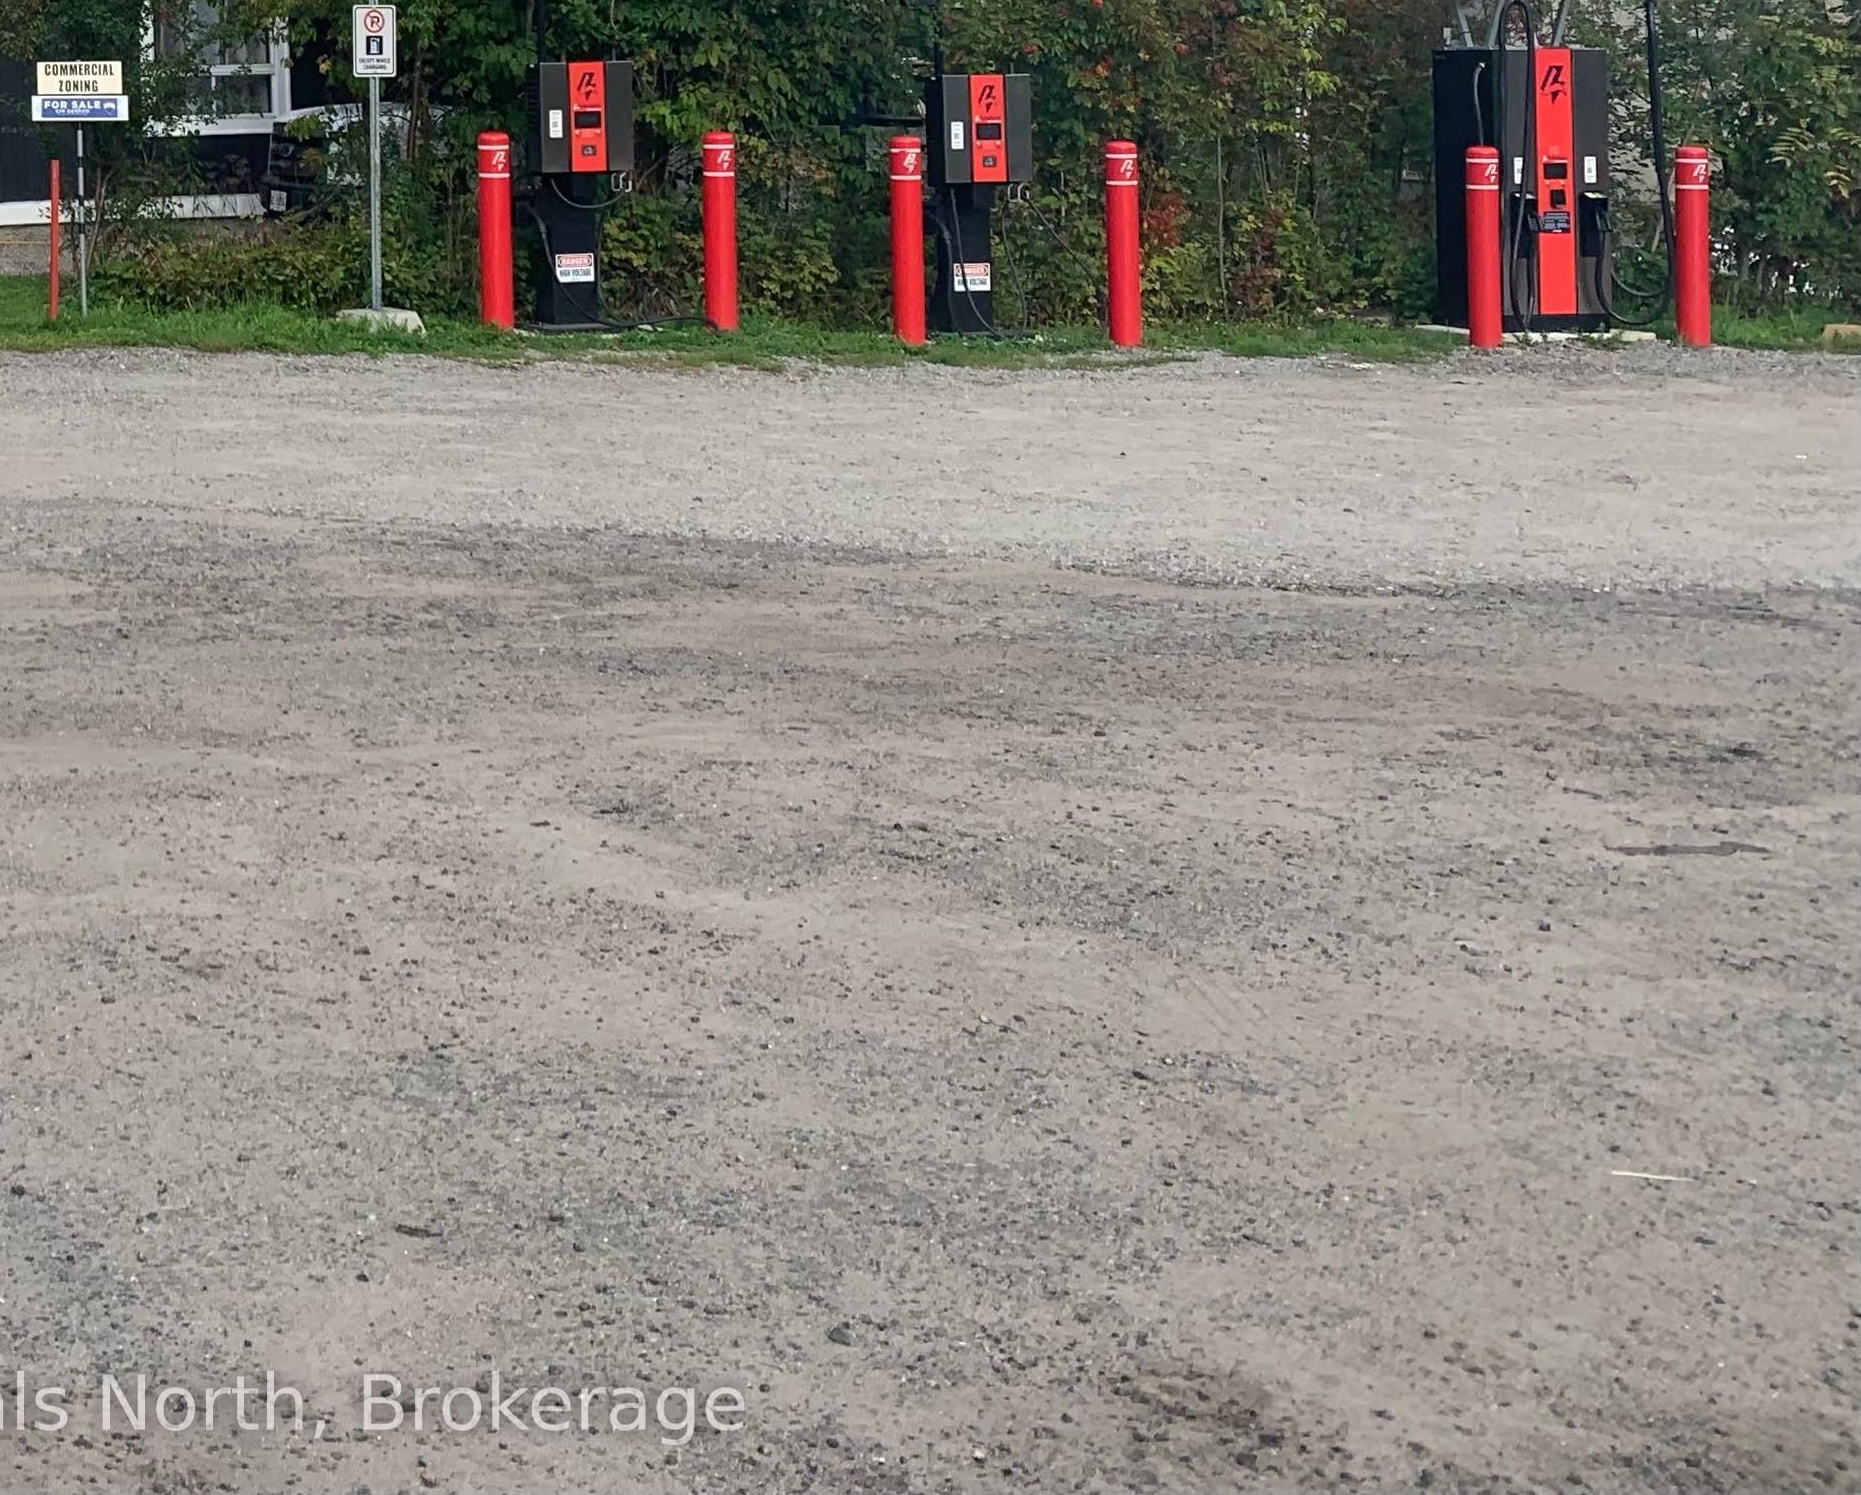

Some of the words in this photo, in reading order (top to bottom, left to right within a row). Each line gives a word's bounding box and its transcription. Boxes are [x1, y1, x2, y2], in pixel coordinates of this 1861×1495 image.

[44, 63, 114, 76] COMMERCIAL
[58, 80, 99, 92] ZONING
[44, 101, 68, 109] FOR
[71, 101, 101, 109] SALE
